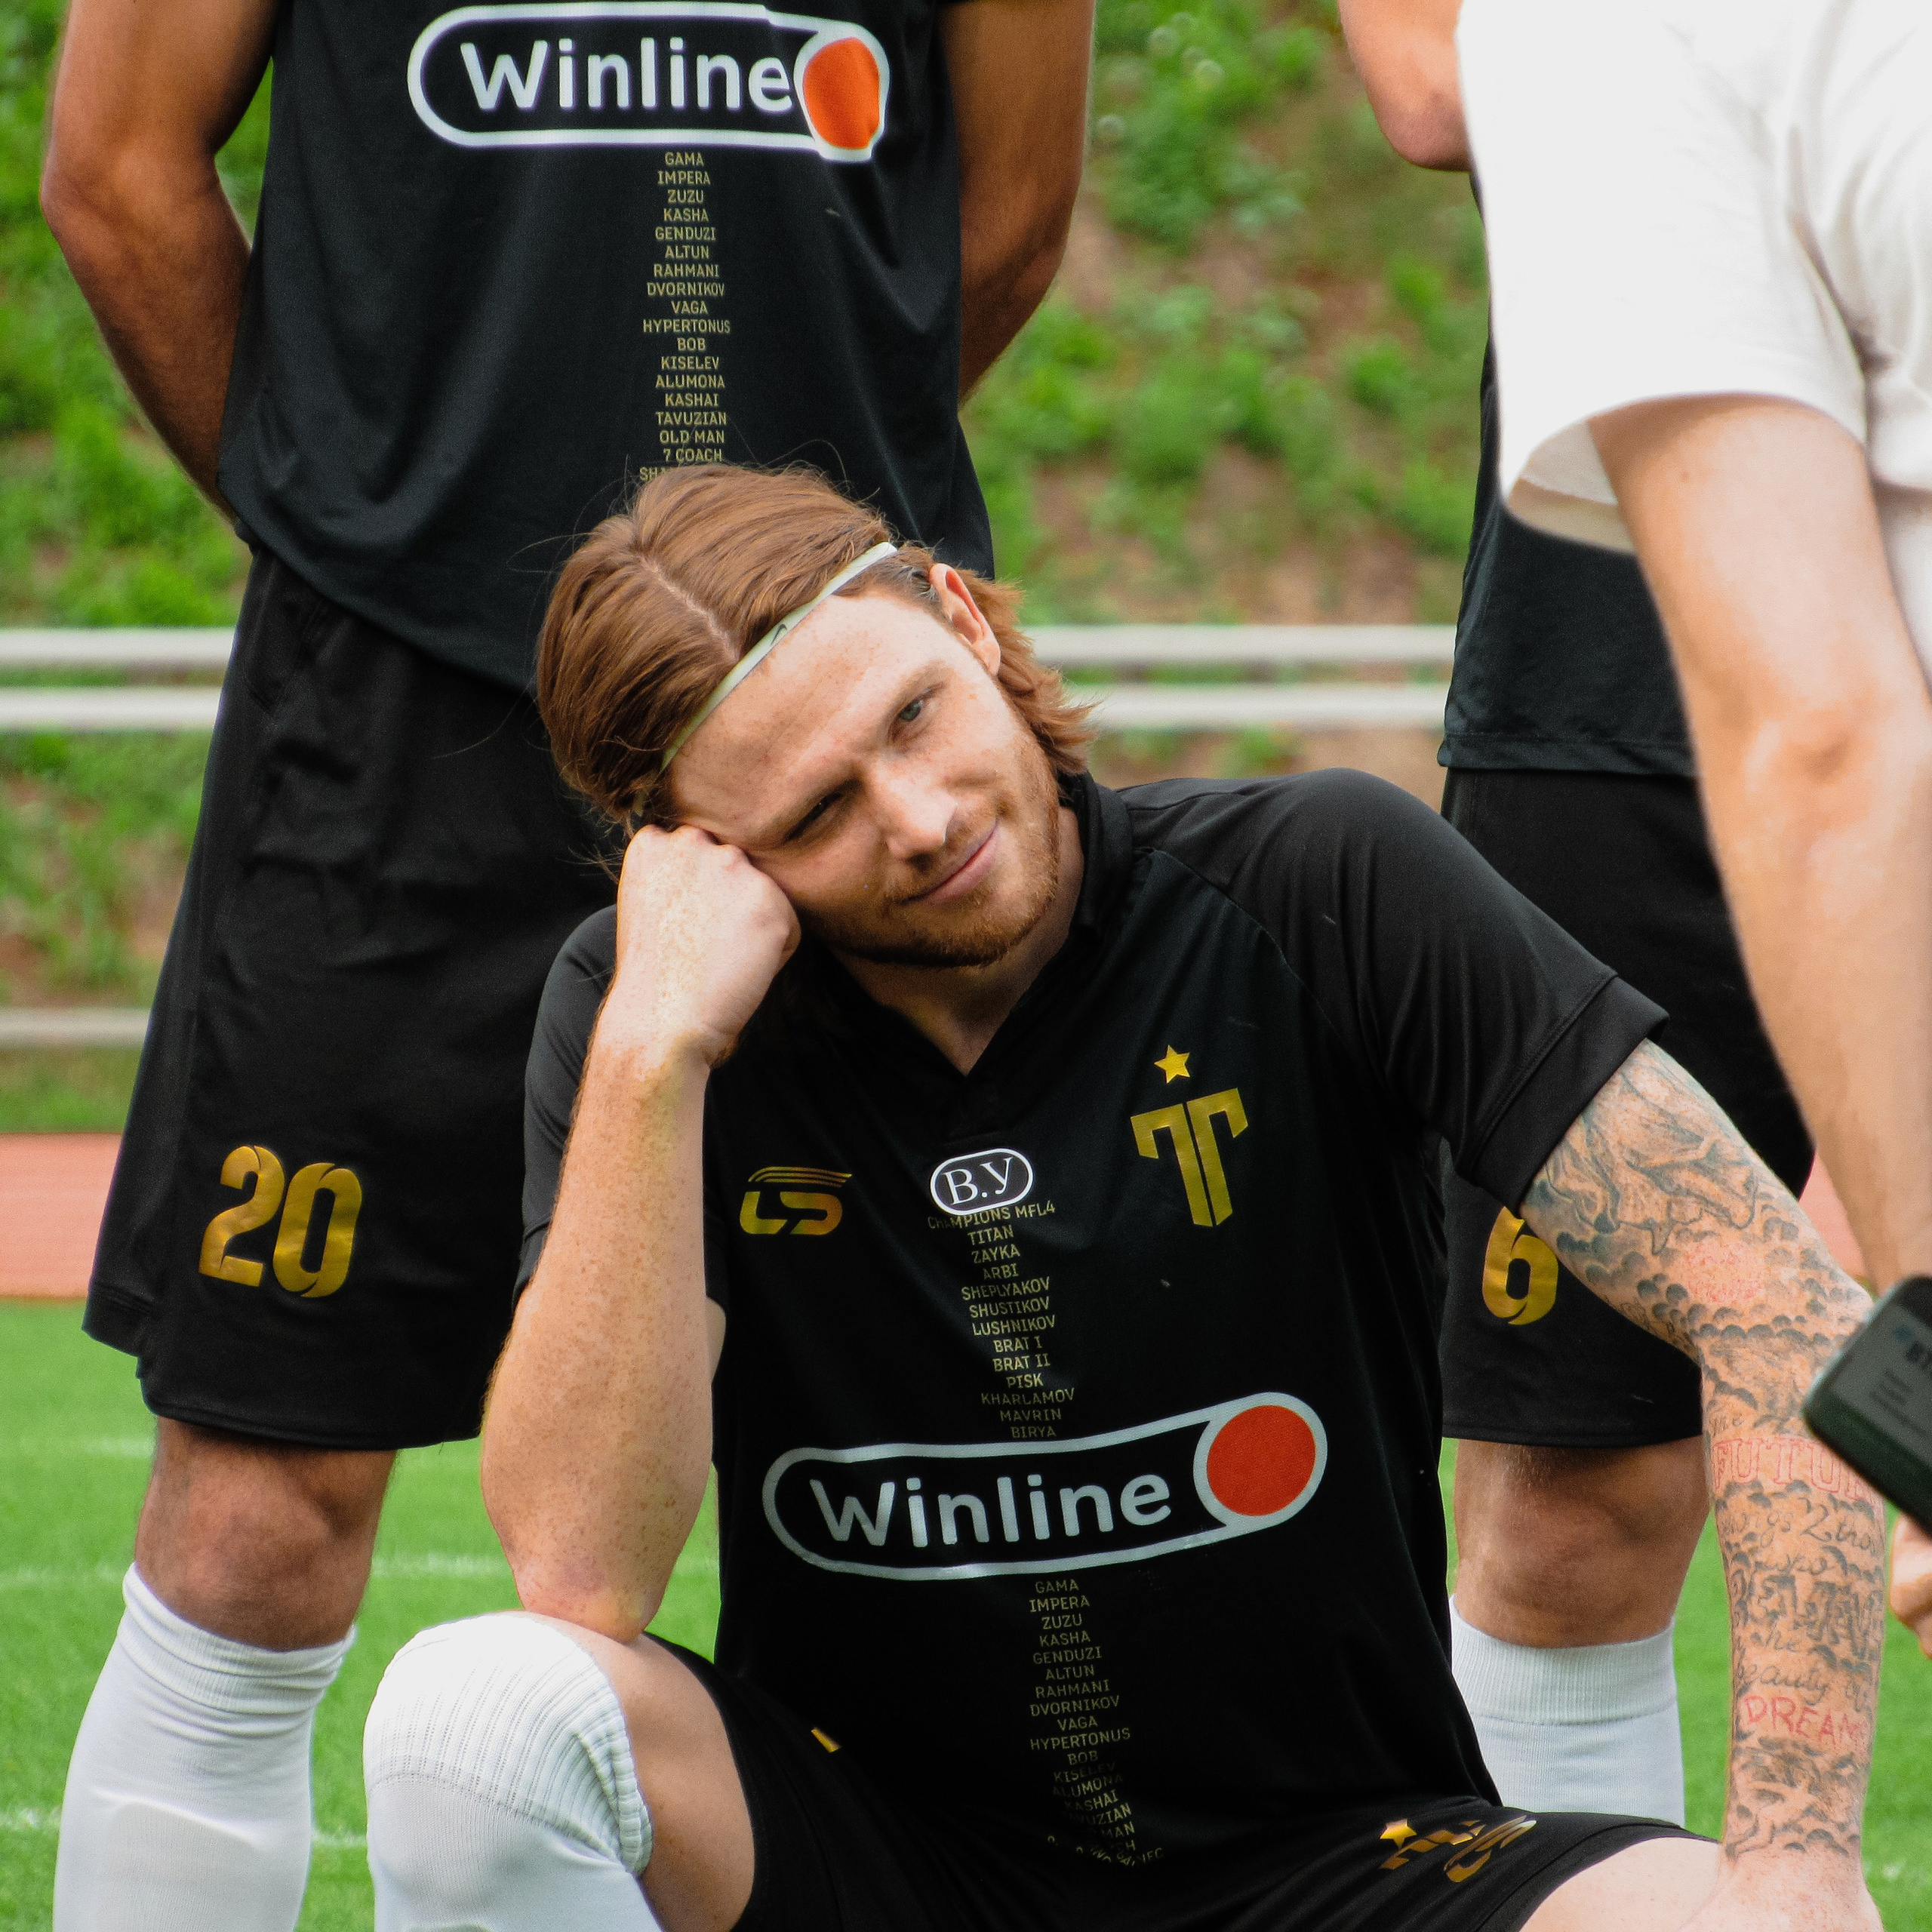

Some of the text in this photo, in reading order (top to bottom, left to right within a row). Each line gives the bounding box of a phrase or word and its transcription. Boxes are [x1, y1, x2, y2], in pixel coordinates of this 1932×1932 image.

[460, 37, 792, 112] Winline
[664, 152, 704, 166] GAMA
[657, 171, 711, 185] IMPERA
[667, 189, 704, 203] ZUZU
[663, 208, 709, 222] KASHA
[655, 226, 716, 241] GENDUZI
[664, 245, 710, 259] ALTUN
[654, 263, 720, 278] RAHMANI
[647, 282, 725, 297] DVORNIKOV
[671, 300, 709, 315] VAGA
[643, 318, 731, 334] HYPERTONUS
[677, 337, 706, 352] BOB
[661, 356, 719, 370] KISELEV
[655, 374, 725, 389] ALUMONA
[665, 393, 719, 407] KASHAI
[656, 411, 727, 426] TAVUZIAN
[660, 430, 725, 444] OLD MAN
[663, 448, 722, 462] 7 COACH
[1014, 1200, 1056, 1218] MFL4
[198, 1145, 362, 1298] 20
[968, 1225, 1014, 1245] TITAN
[971, 1244, 1020, 1264] ZAYKA
[983, 1263, 1019, 1280] ARBI
[961, 1276, 1050, 1301] SHEPLYAKOV
[969, 1296, 1049, 1318] SHUSTIKOV
[972, 1315, 1055, 1336] LUSHNIKOV
[992, 1336, 1043, 1353] BRAT I
[992, 1353, 1051, 1372] BRAT II
[1006, 1373, 1044, 1389] PISK
[981, 1388, 1075, 1404] KHARLAMOV
[1000, 1408, 1062, 1422] MAVRIN
[1011, 1426, 1057, 1438] BIRYA
[810, 1472, 1171, 1549] Winline
[1035, 1579, 1079, 1594] GAMA
[1029, 1595, 1091, 1613] IMPERA
[1041, 1614, 1083, 1630] ZUZU
[1039, 1630, 1091, 1647] KASHA
[1033, 1646, 1103, 1664] GENDUZI
[1045, 1664, 1095, 1681] ALTUN
[1035, 1679, 1111, 1699] RAHMANI
[1029, 1695, 1120, 1717] DVORNIKOV
[1057, 1715, 1098, 1731] VAGA
[1030, 1727, 1131, 1750] HYPERTONUS
[1067, 1750, 1098, 1765] BOB
